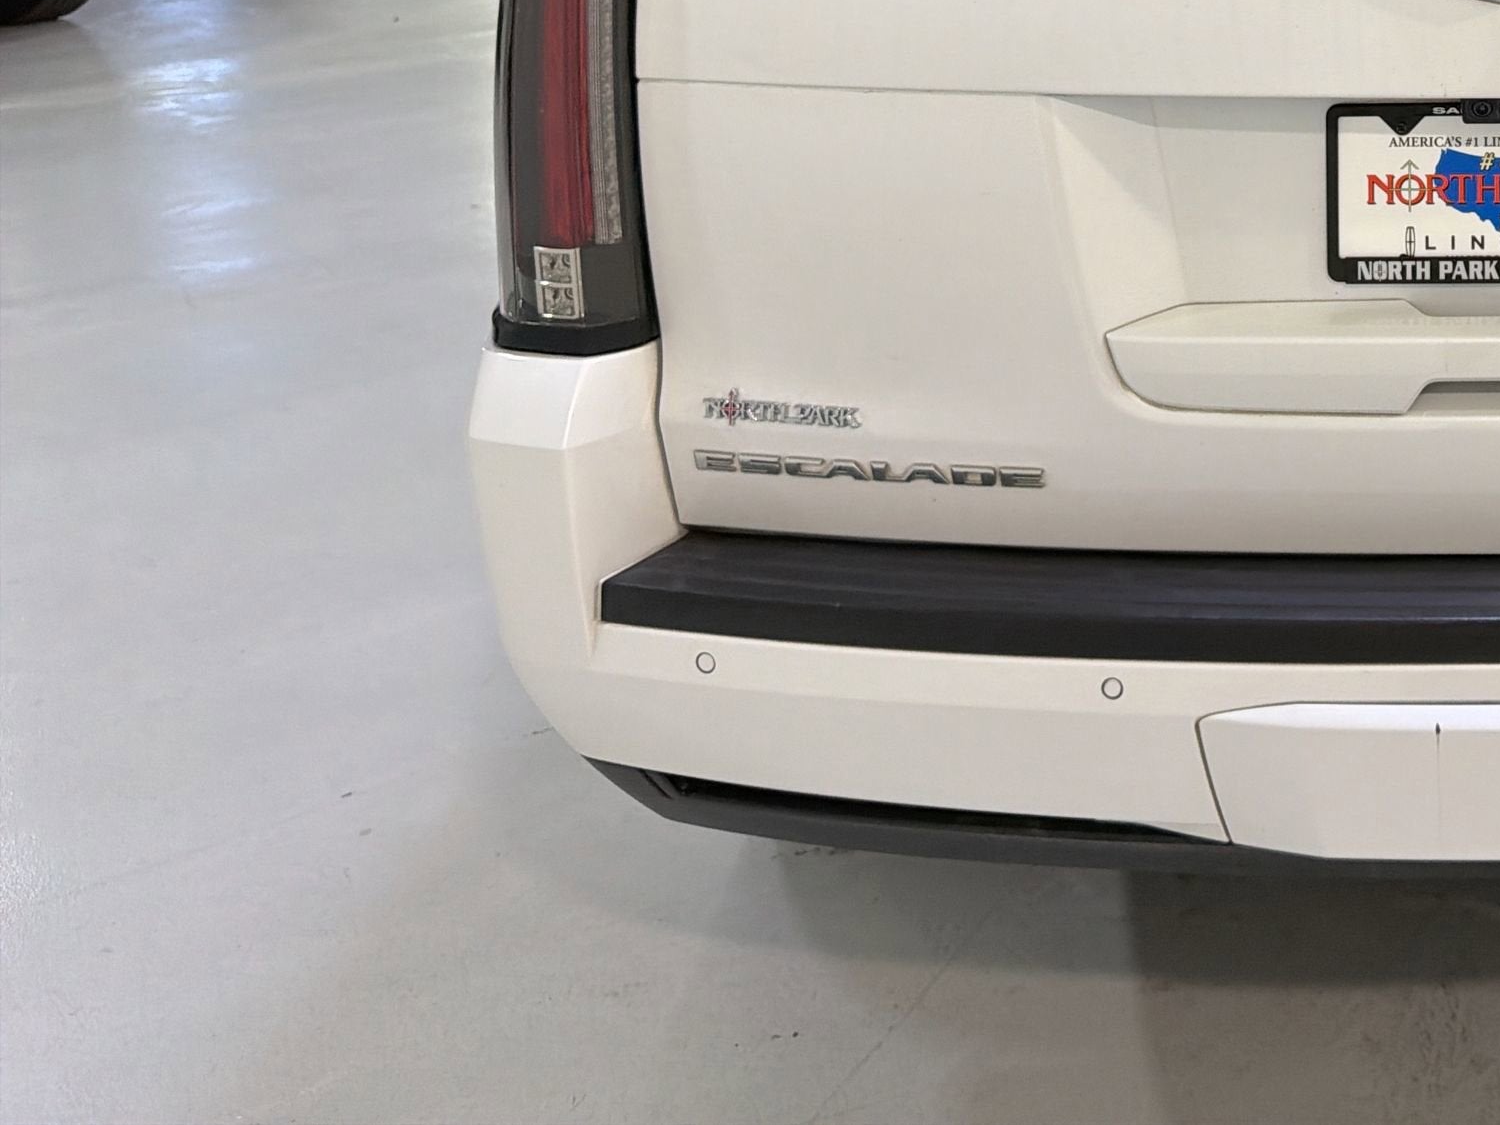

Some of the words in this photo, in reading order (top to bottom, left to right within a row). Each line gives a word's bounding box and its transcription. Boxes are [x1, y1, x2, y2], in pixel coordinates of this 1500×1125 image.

[1432, 106, 1462, 115] SA
[1388, 136, 1462, 148] AMERICA'S
[1465, 136, 1479, 148] #1
[1357, 259, 1431, 281] NORTH
[1438, 259, 1500, 280] PARK
[702, 396, 790, 424] NORTH
[793, 402, 864, 429] PARK
[693, 448, 1047, 488] ESCALADE
